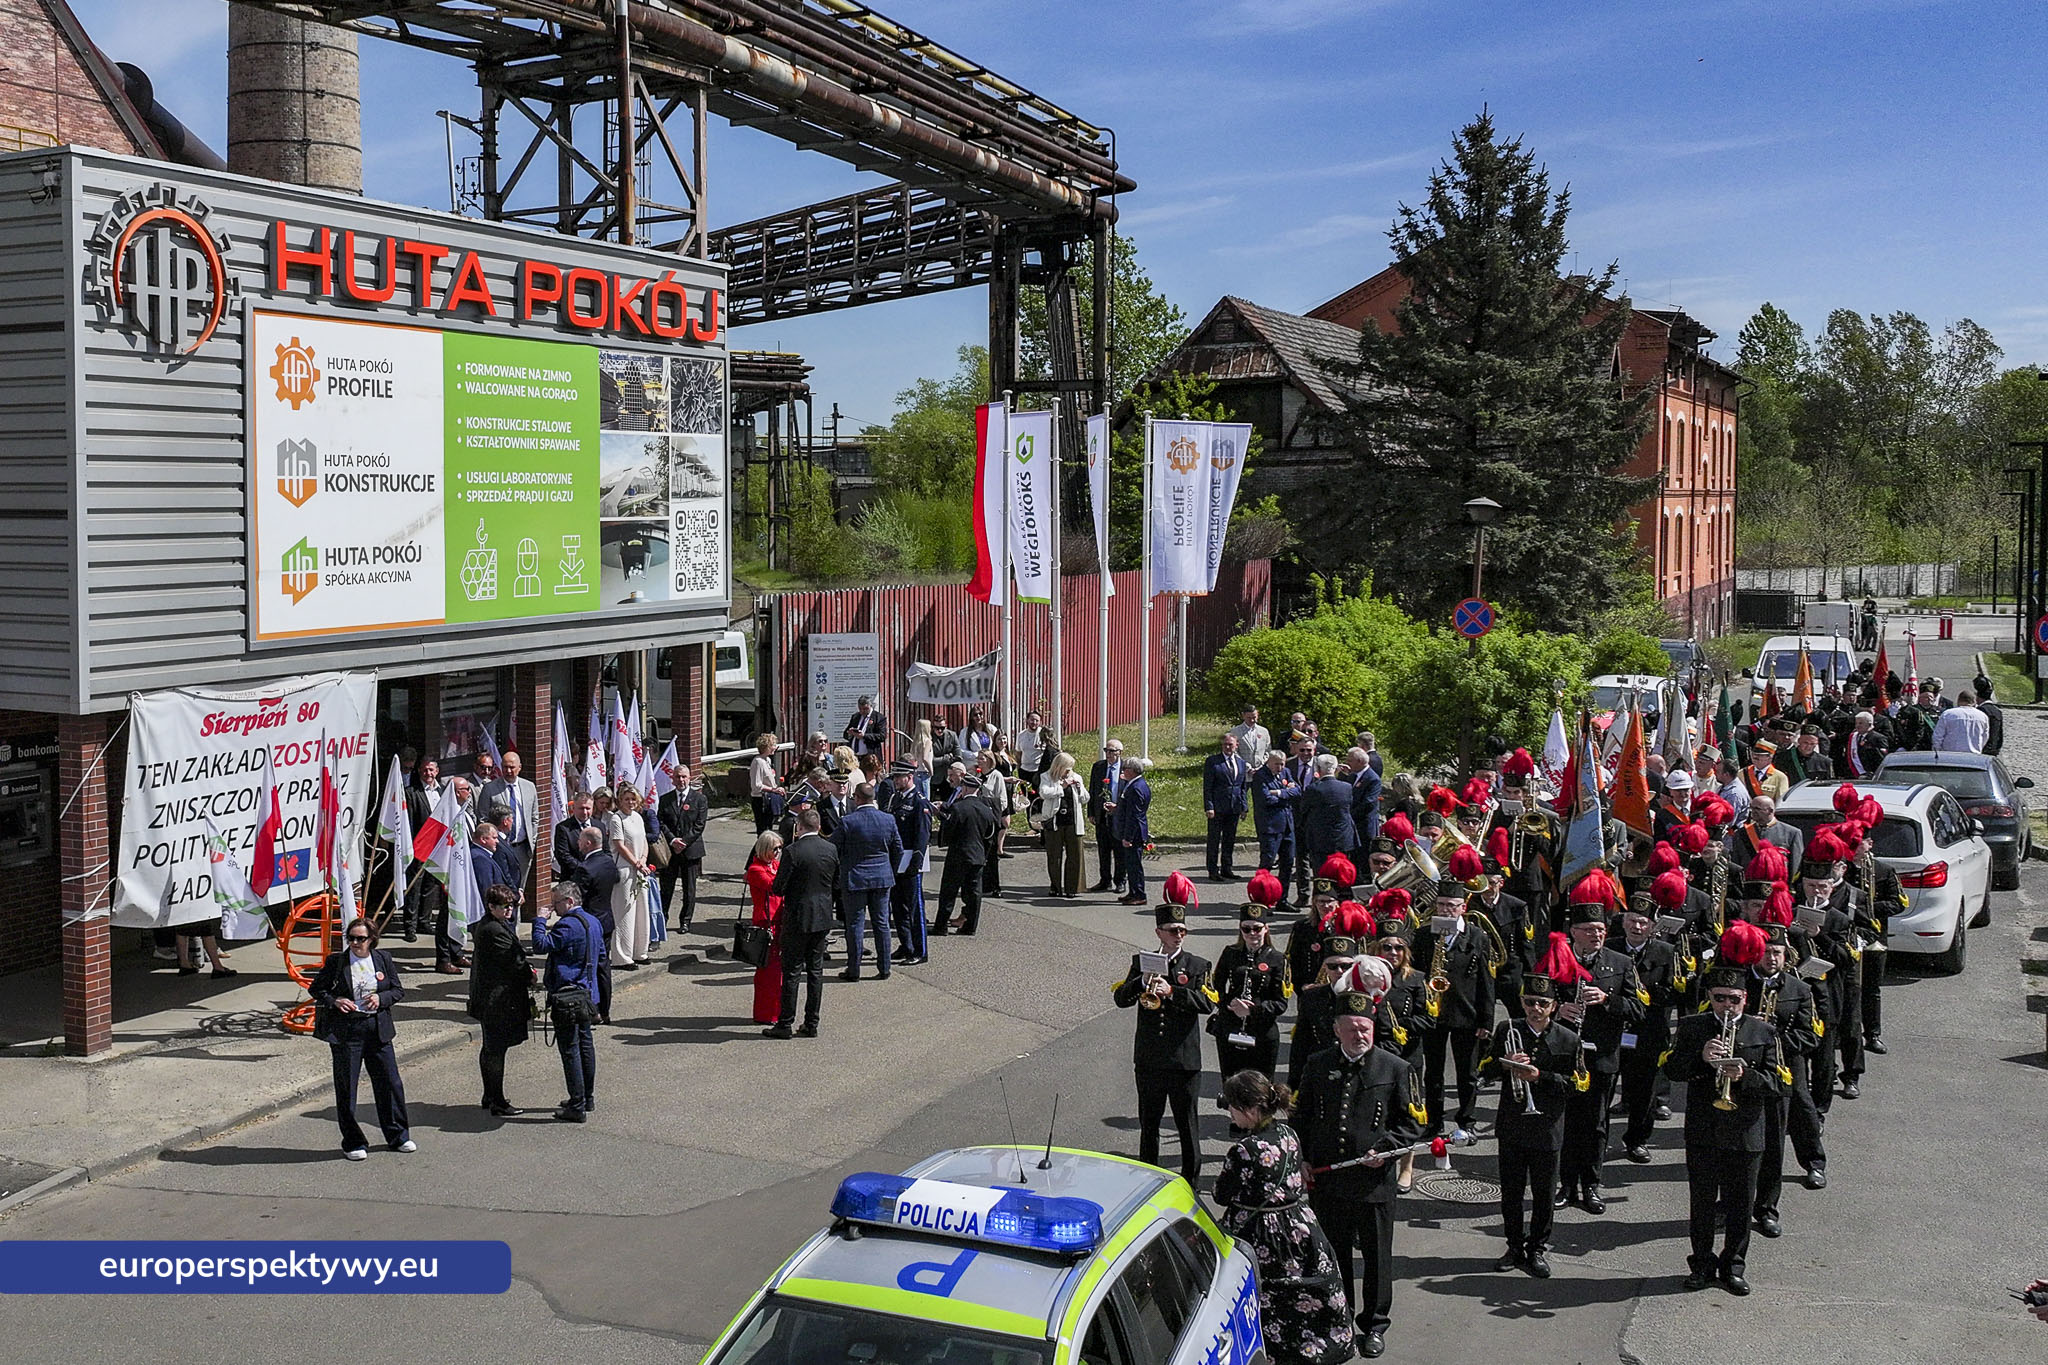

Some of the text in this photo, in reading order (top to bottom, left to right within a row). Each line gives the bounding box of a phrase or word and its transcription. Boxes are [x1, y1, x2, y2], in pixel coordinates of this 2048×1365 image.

[276, 220, 718, 342] HUTA POKÓJ
[327, 356, 393, 374] HUTA POKÓJ
[465, 362, 572, 383] FORMOWANE NA ZIMNO
[327, 376, 393, 399] PROFILE
[465, 381, 578, 402] WALCOWANE NA GORĄCO
[465, 416, 572, 433] KONSTRUKCJE STALOWE
[466, 435, 581, 451] KSZTAŁTOWNIKI SPAWANE
[324, 452, 391, 468] HUTA POKÓJ
[324, 473, 435, 493] KONSTRUKCJE
[466, 471, 573, 485] USŁUGI LABORATORYJNE
[466, 487, 574, 504] SPRZEDAŻ PRĄDU I GAZU
[325, 540, 422, 566] HUTA POKÓJ
[325, 570, 412, 587] SPÓŁKA AKCYJNA
[200, 701, 320, 737] Sierpień 80
[17, 744, 60, 758] bankoma
[138, 760, 179, 790] TEN
[181, 747, 267, 783] ZAKŁAD
[897, 1201, 979, 1236] POLICJA
